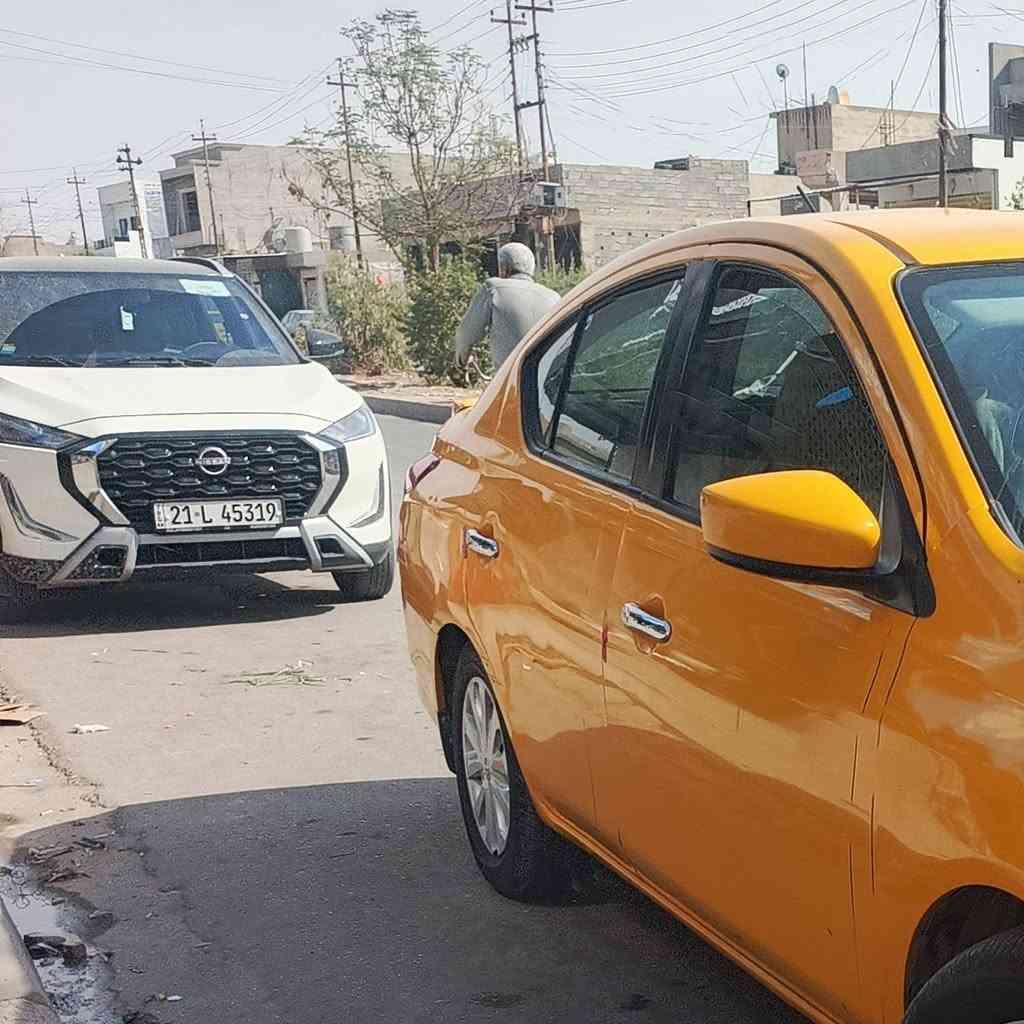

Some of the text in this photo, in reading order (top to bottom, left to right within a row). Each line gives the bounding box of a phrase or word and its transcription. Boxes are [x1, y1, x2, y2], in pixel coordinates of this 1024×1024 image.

[170, 505, 193, 525] 21
[201, 505, 213, 524] L
[221, 502, 276, 522] 45319
